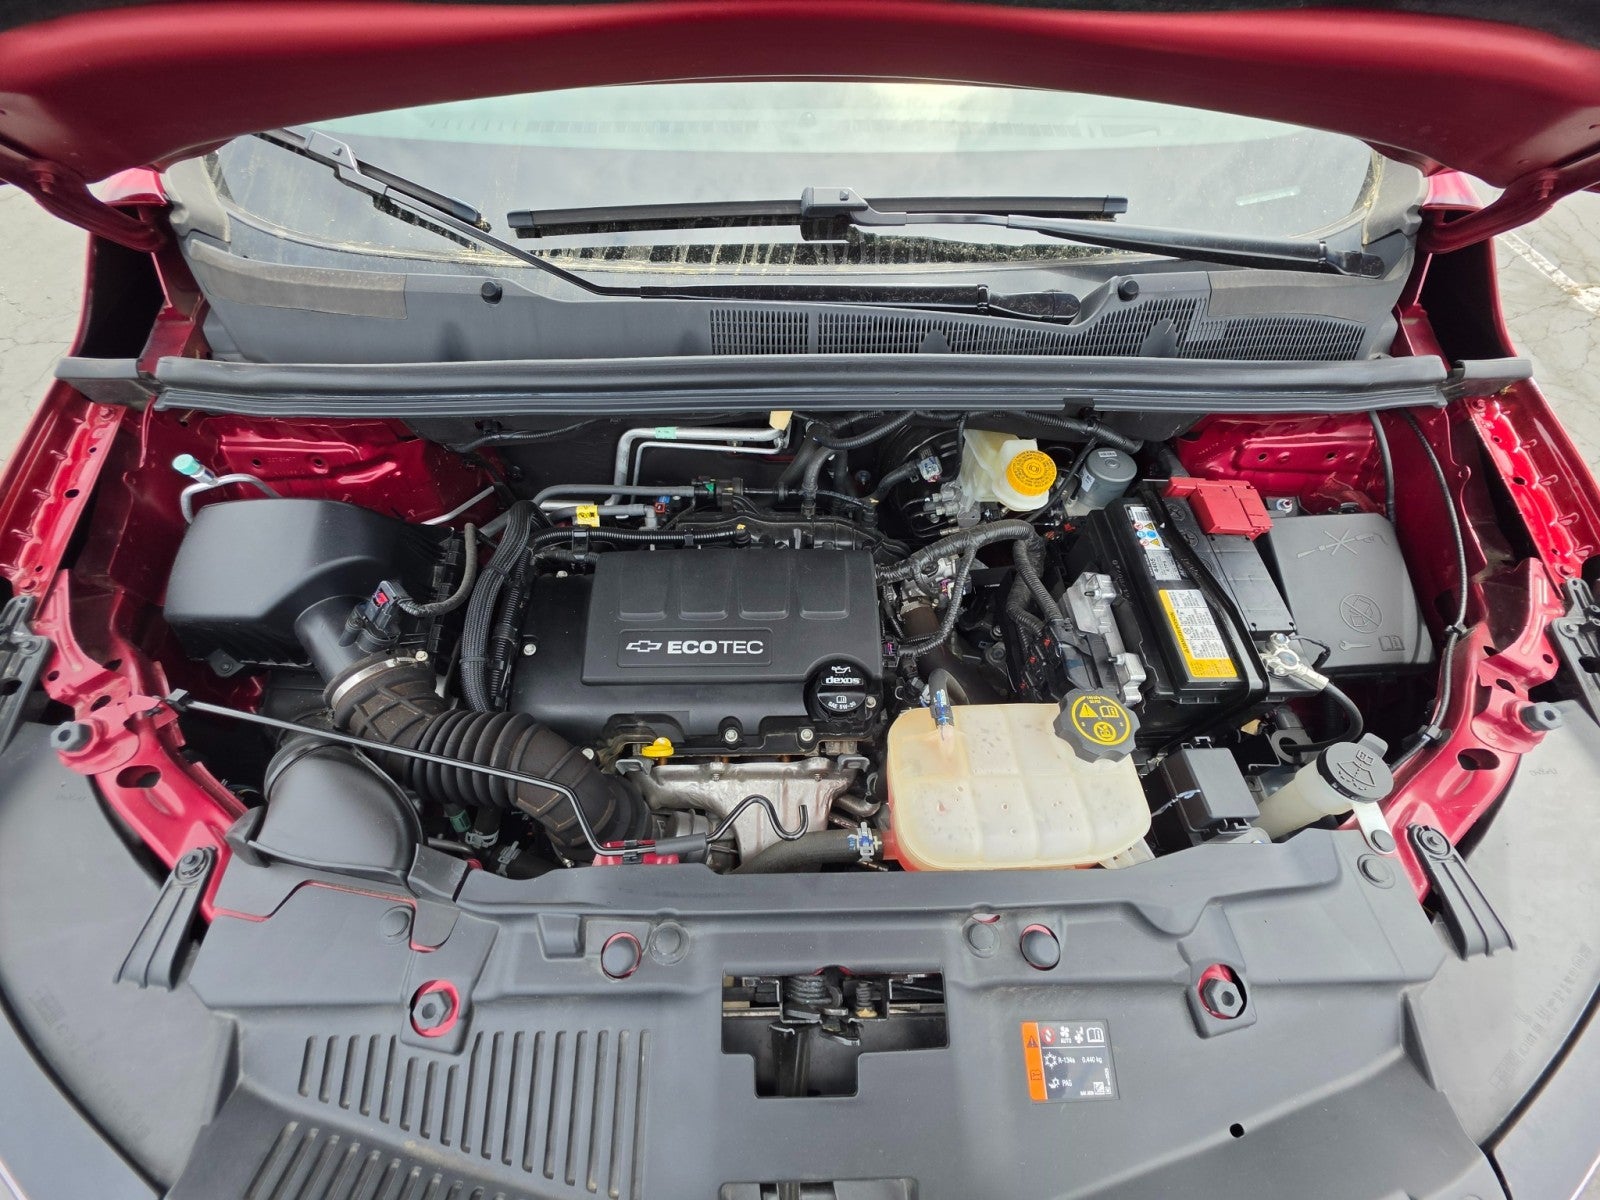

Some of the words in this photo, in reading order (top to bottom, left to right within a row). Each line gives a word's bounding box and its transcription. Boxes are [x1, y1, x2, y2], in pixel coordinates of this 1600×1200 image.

[667, 640, 764, 654] ECOTEC
[825, 675, 861, 685] dexos
[828, 701, 839, 709] SAE
